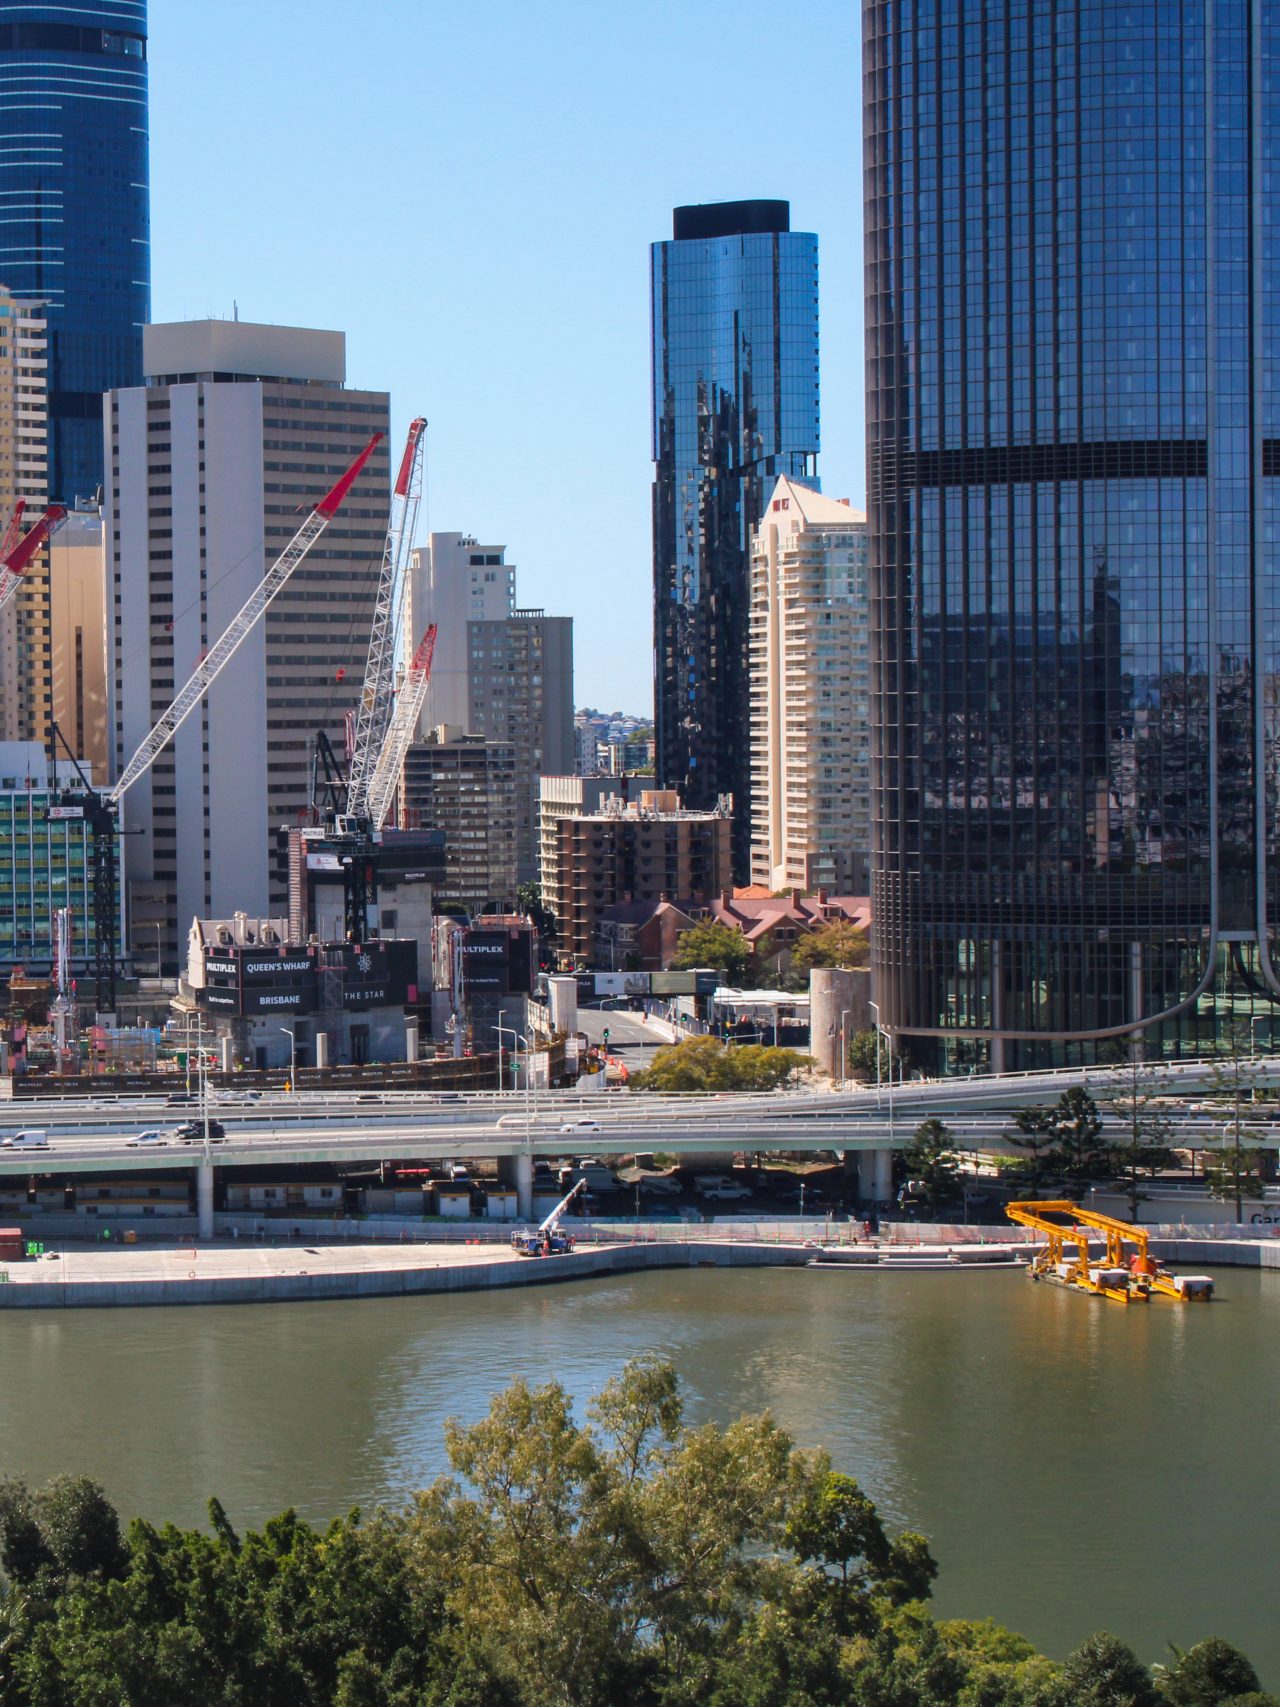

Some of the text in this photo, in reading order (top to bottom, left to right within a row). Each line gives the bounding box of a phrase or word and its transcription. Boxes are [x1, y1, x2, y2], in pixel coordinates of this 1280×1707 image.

[206, 962, 237, 973] MULTIPLEX
[246, 961, 311, 973] QUEEN'S WHARF
[259, 995, 300, 1005] BRISBANE
[344, 990, 385, 1000] THE STAR
